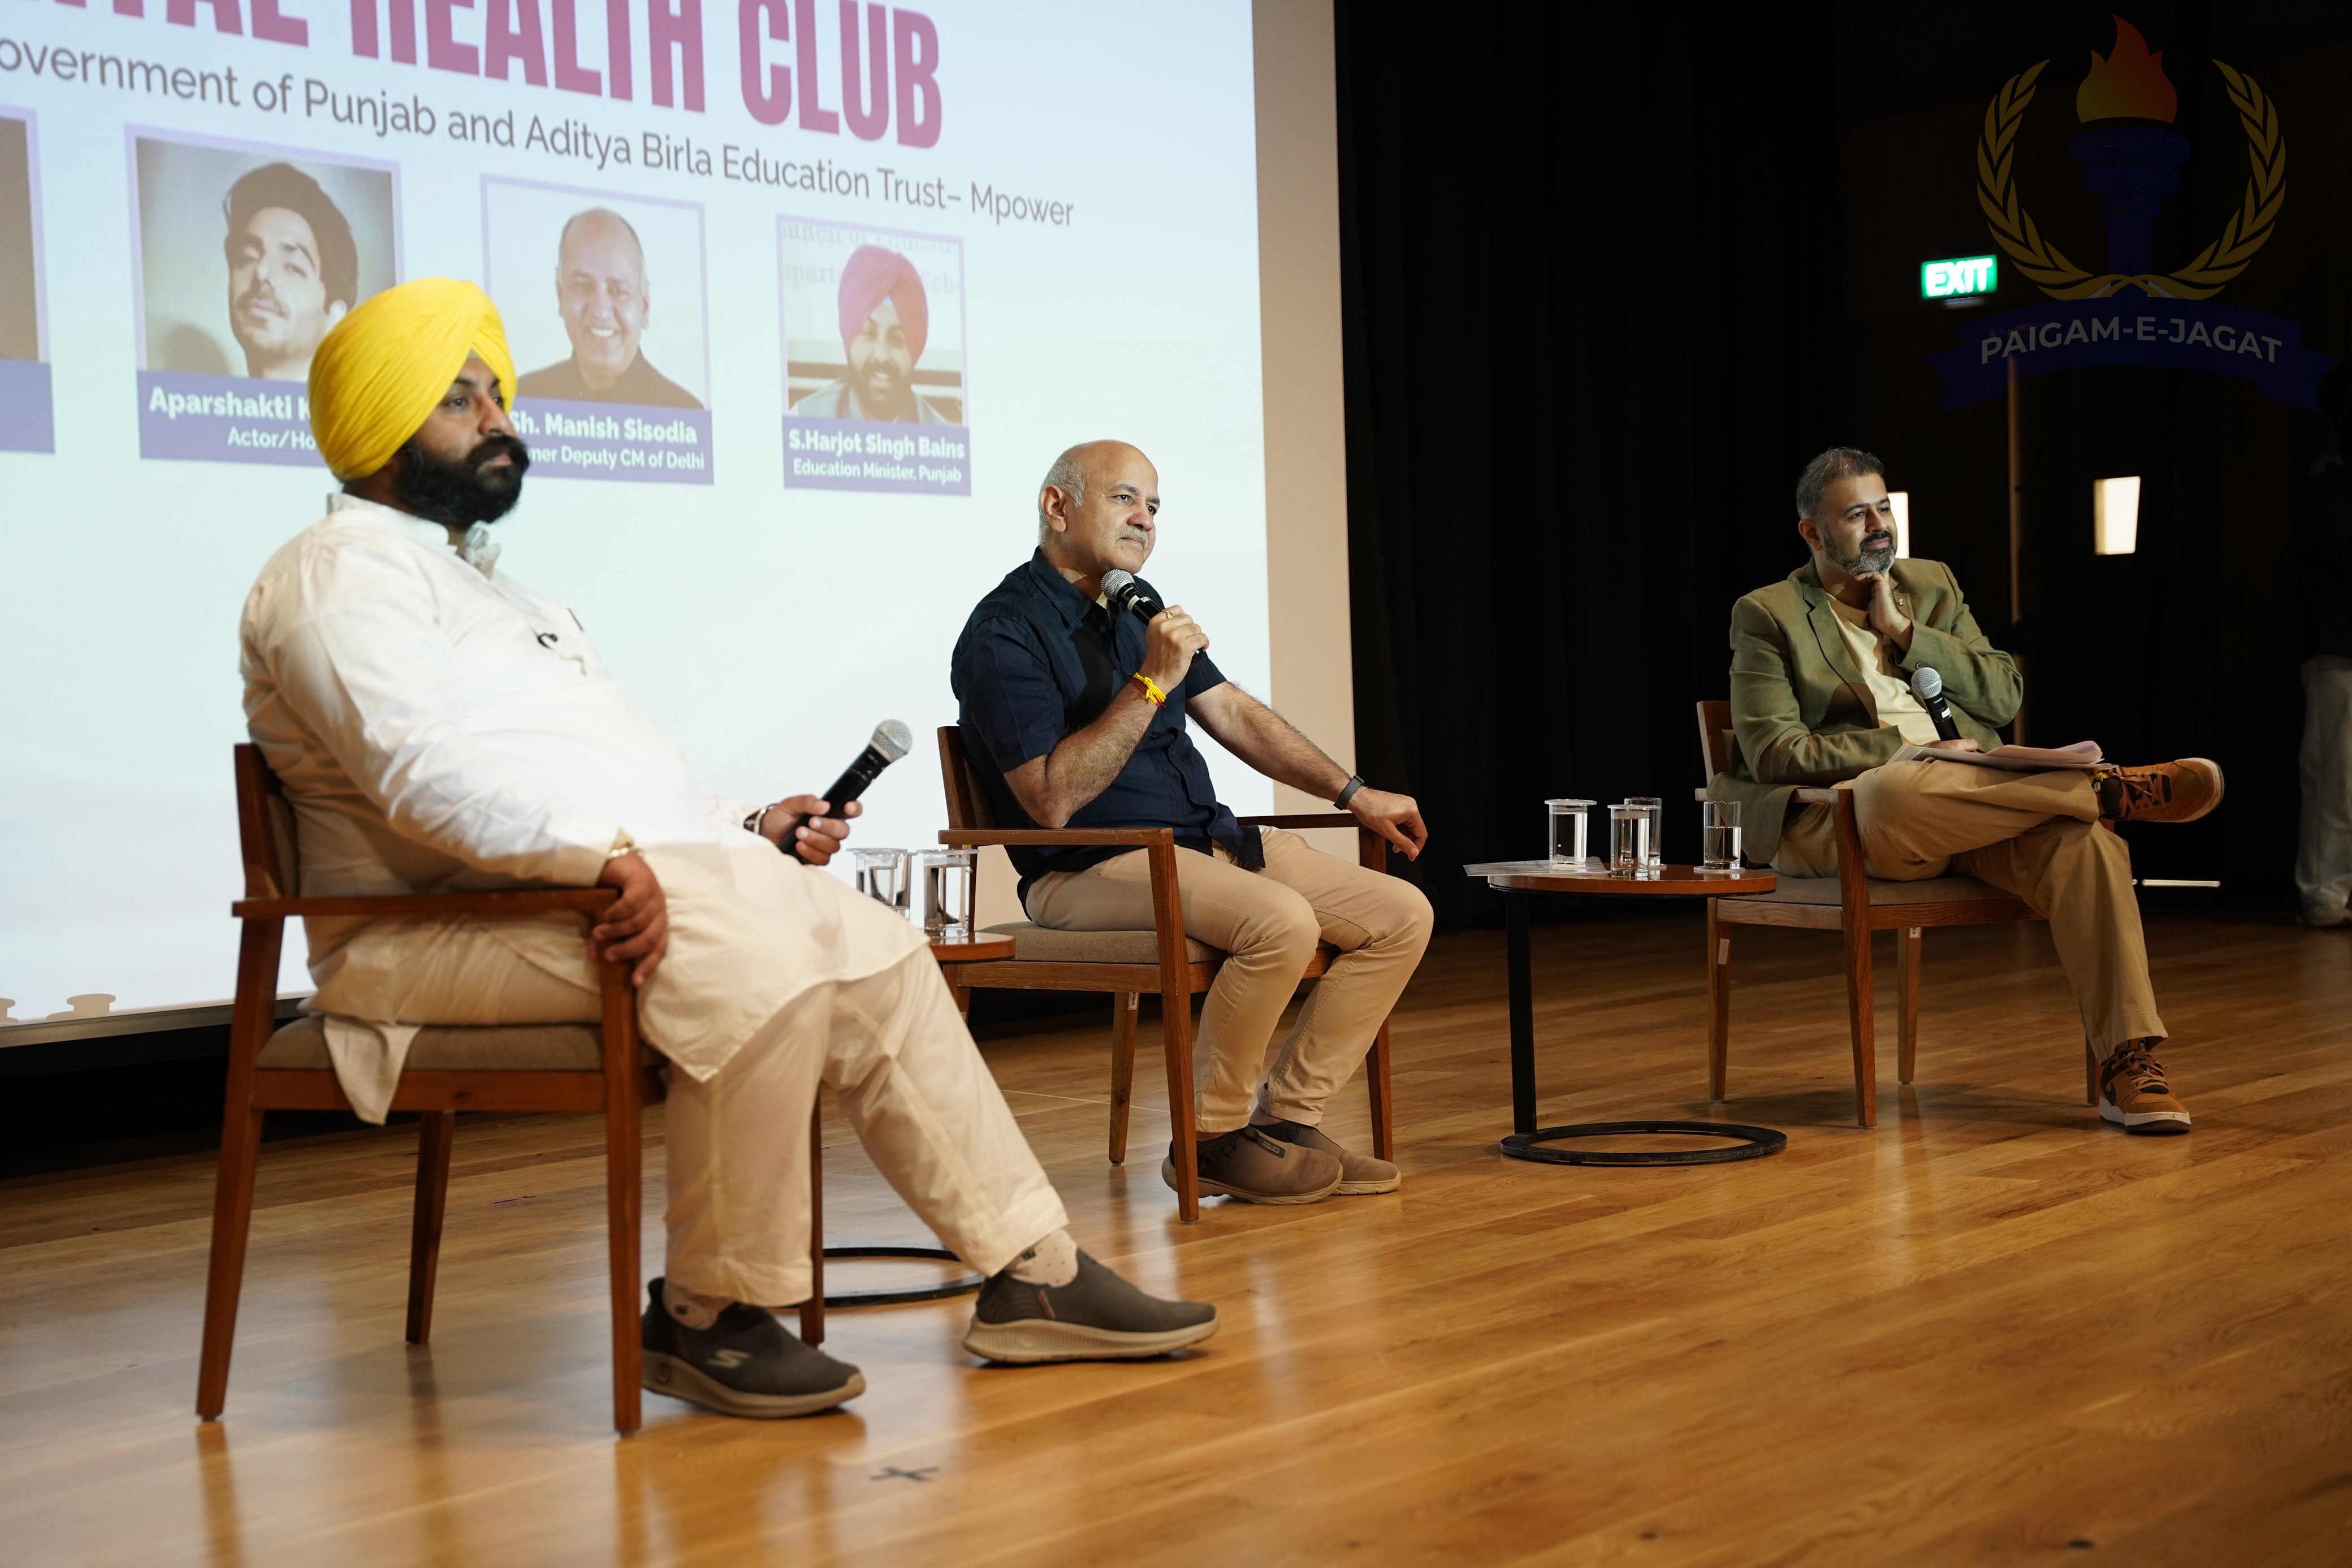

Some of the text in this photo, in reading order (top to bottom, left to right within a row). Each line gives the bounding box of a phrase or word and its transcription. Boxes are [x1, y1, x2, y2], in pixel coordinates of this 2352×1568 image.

[738, 0, 942, 149] CLUB
[0, 37, 240, 107] overnment
[252, 73, 293, 114] of
[304, 78, 436, 136] Punjab
[448, 110, 515, 148] and
[525, 115, 631, 171] Aditya
[642, 132, 713, 176] Birla
[723, 144, 870, 199] Education
[971, 181, 1075, 226] Mpower
[1925, 257, 1992, 297] EXIT
[149, 386, 311, 421] Aparshakti K
[227, 426, 317, 451] Actor/Ho
[509, 410, 698, 445] Sh. Manish Sisodia
[788, 428, 966, 461] S.Harjot Singh Bains
[528, 445, 705, 470] mer Deputy CM of Delhi
[793, 457, 861, 478] Education
[918, 464, 962, 486] Punjab
